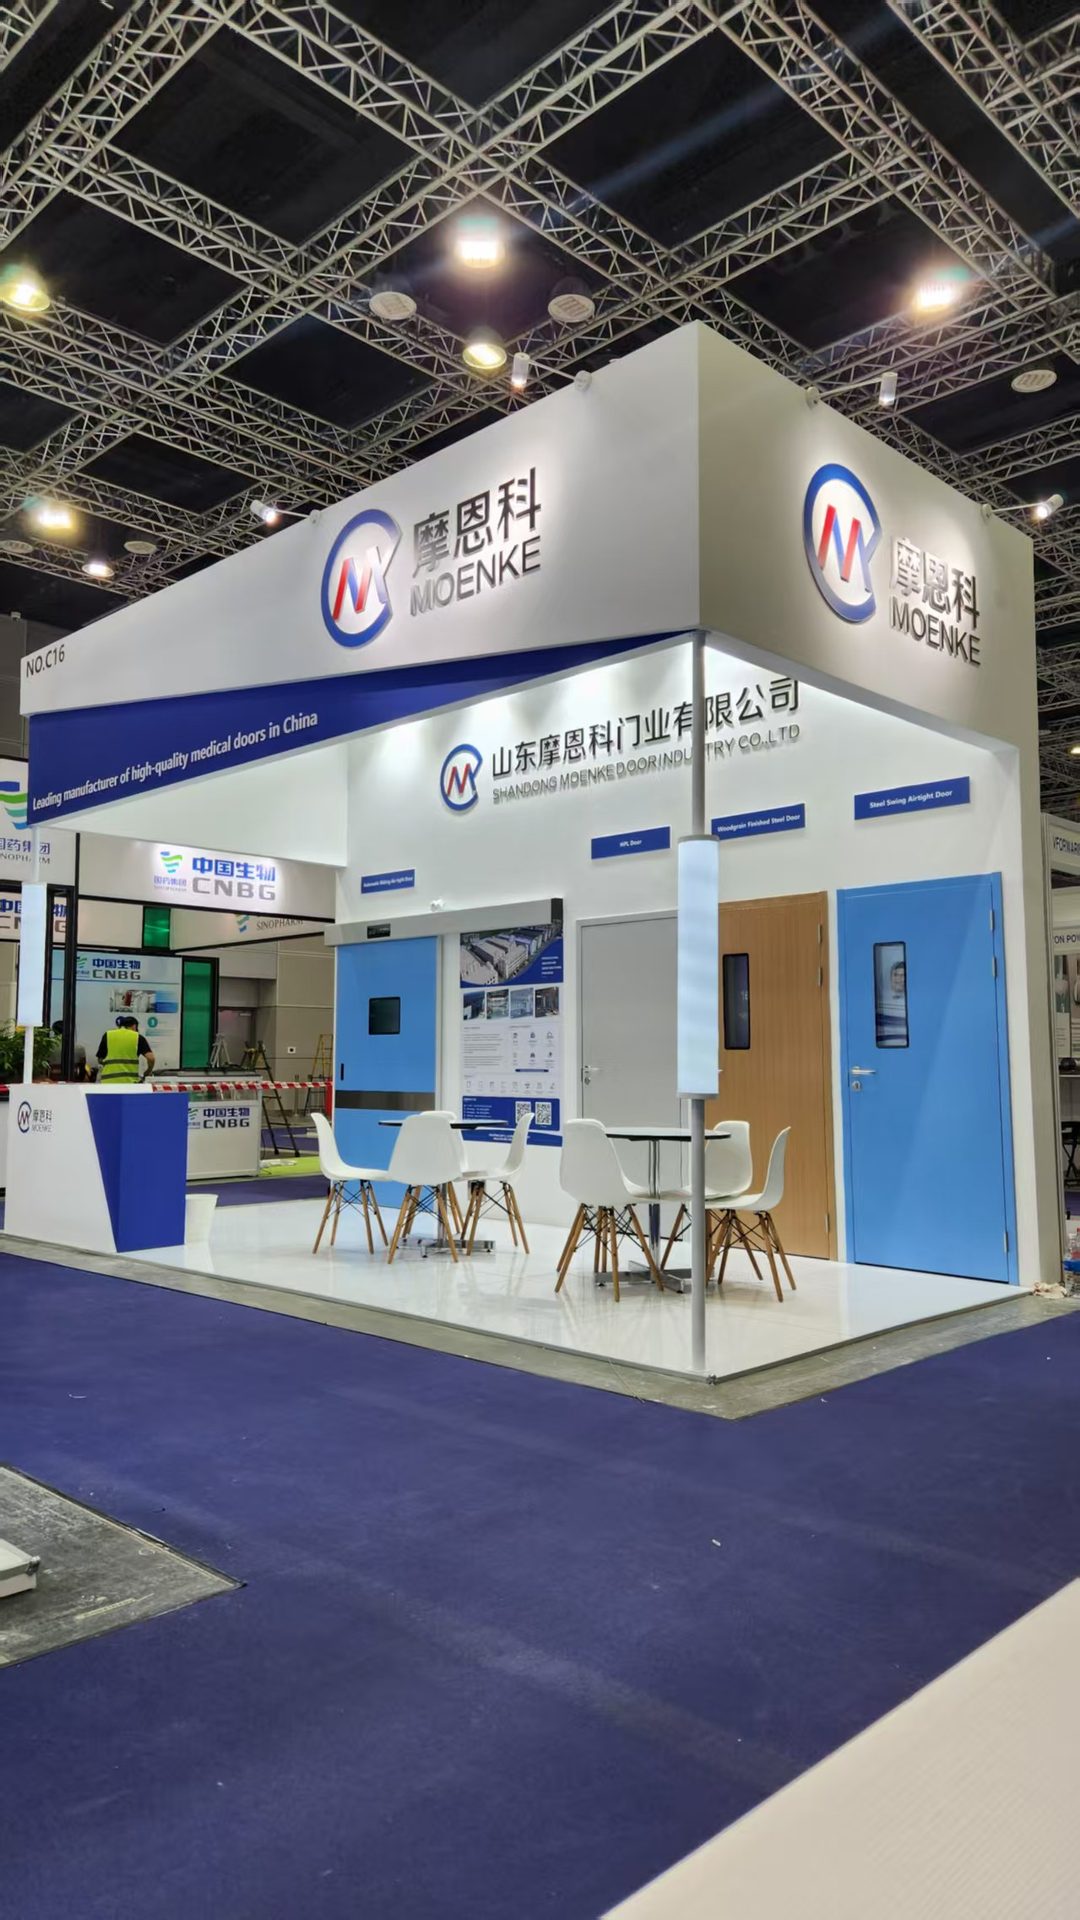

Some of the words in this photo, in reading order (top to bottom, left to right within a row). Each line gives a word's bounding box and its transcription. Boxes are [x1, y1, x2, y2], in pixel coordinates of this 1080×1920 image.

[412, 467, 541, 578] 摩恩科
[410, 535, 541, 617] MOENKE
[890, 537, 980, 630] 摩恩科
[890, 596, 981, 667] MOENKE
[26, 644, 65, 678] NO.C16
[492, 677, 799, 779] 山东摩恩科门业有限公司
[33, 790, 62, 811] Leading
[63, 775, 118, 801] manufacturer
[119, 770, 130, 783] of
[131, 752, 189, 783] high-quality
[190, 736, 231, 763] medical
[234, 728, 266, 749] doors
[269, 722, 281, 739] in
[283, 713, 318, 734] China
[492, 775, 557, 803] SHANDONG
[560, 763, 615, 789] MOENKE
[616, 754, 657, 777] DOOR
[658, 736, 735, 770] INDUTRY
[869, 801, 885, 809] Steel
[886, 798, 907, 806] Swing
[907, 793, 934, 803] Airtight
[935, 790, 953, 799] Door
[717, 822, 747, 833] Woodgrain
[771, 815, 785, 824] Steel
[785, 813, 800, 822] Door
[192, 857, 276, 882] 中国生物
[192, 877, 276, 901] CNBG
[92, 958, 142, 970] 中国生物
[92, 969, 142, 981] CNBG
[203, 1107, 250, 1118] 中国生物
[203, 1117, 250, 1129] CNBG
